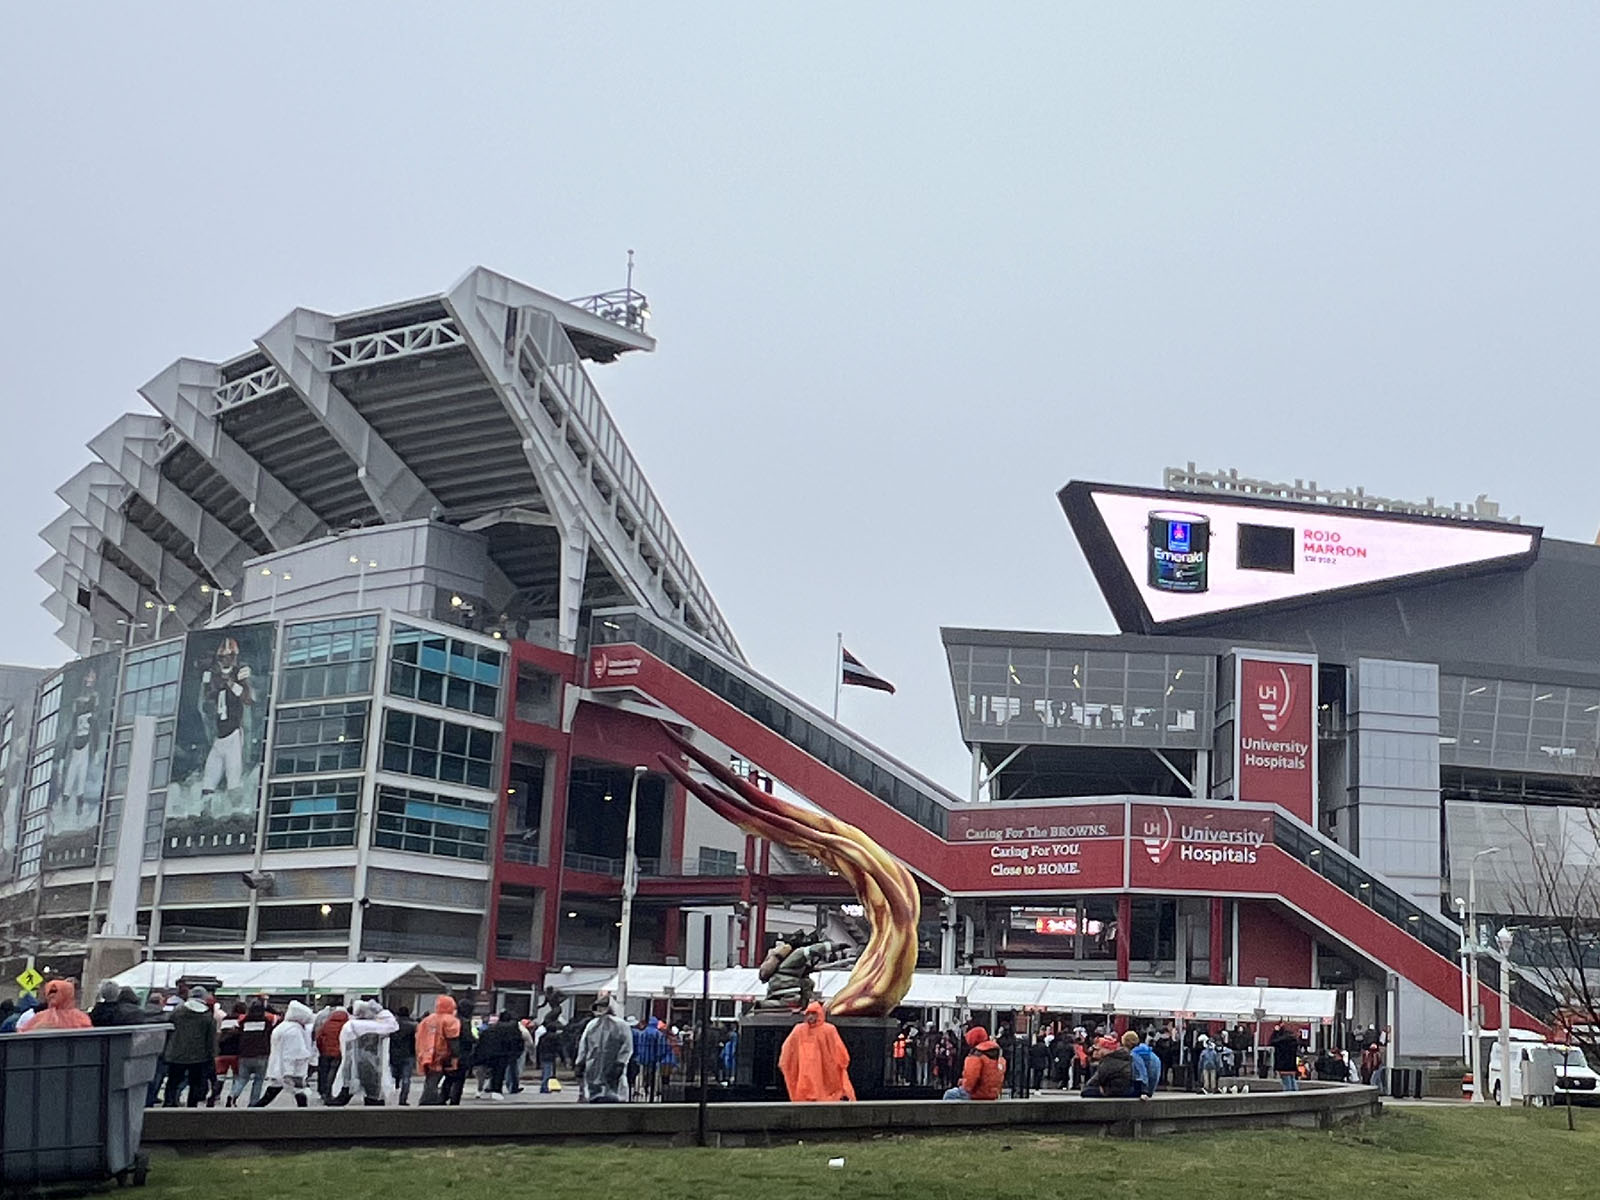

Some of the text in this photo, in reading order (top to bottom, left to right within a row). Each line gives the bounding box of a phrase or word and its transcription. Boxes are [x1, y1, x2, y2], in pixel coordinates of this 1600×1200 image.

[1304, 529, 1341, 543] ROJO
[1154, 547, 1203, 563] Emerald
[1304, 543, 1367, 558] MARRON
[1258, 685, 1277, 700] UH
[1241, 737, 1309, 756] University
[1244, 753, 1306, 770] Hospitals
[965, 824, 1109, 841] Caring For The BROWNS.
[1143, 822, 1160, 835] UH
[1181, 825, 1264, 849] University
[990, 844, 1081, 859] Caring For YOU.
[1180, 844, 1257, 865] Hospitals
[990, 862, 1081, 876] Close to HOME.
